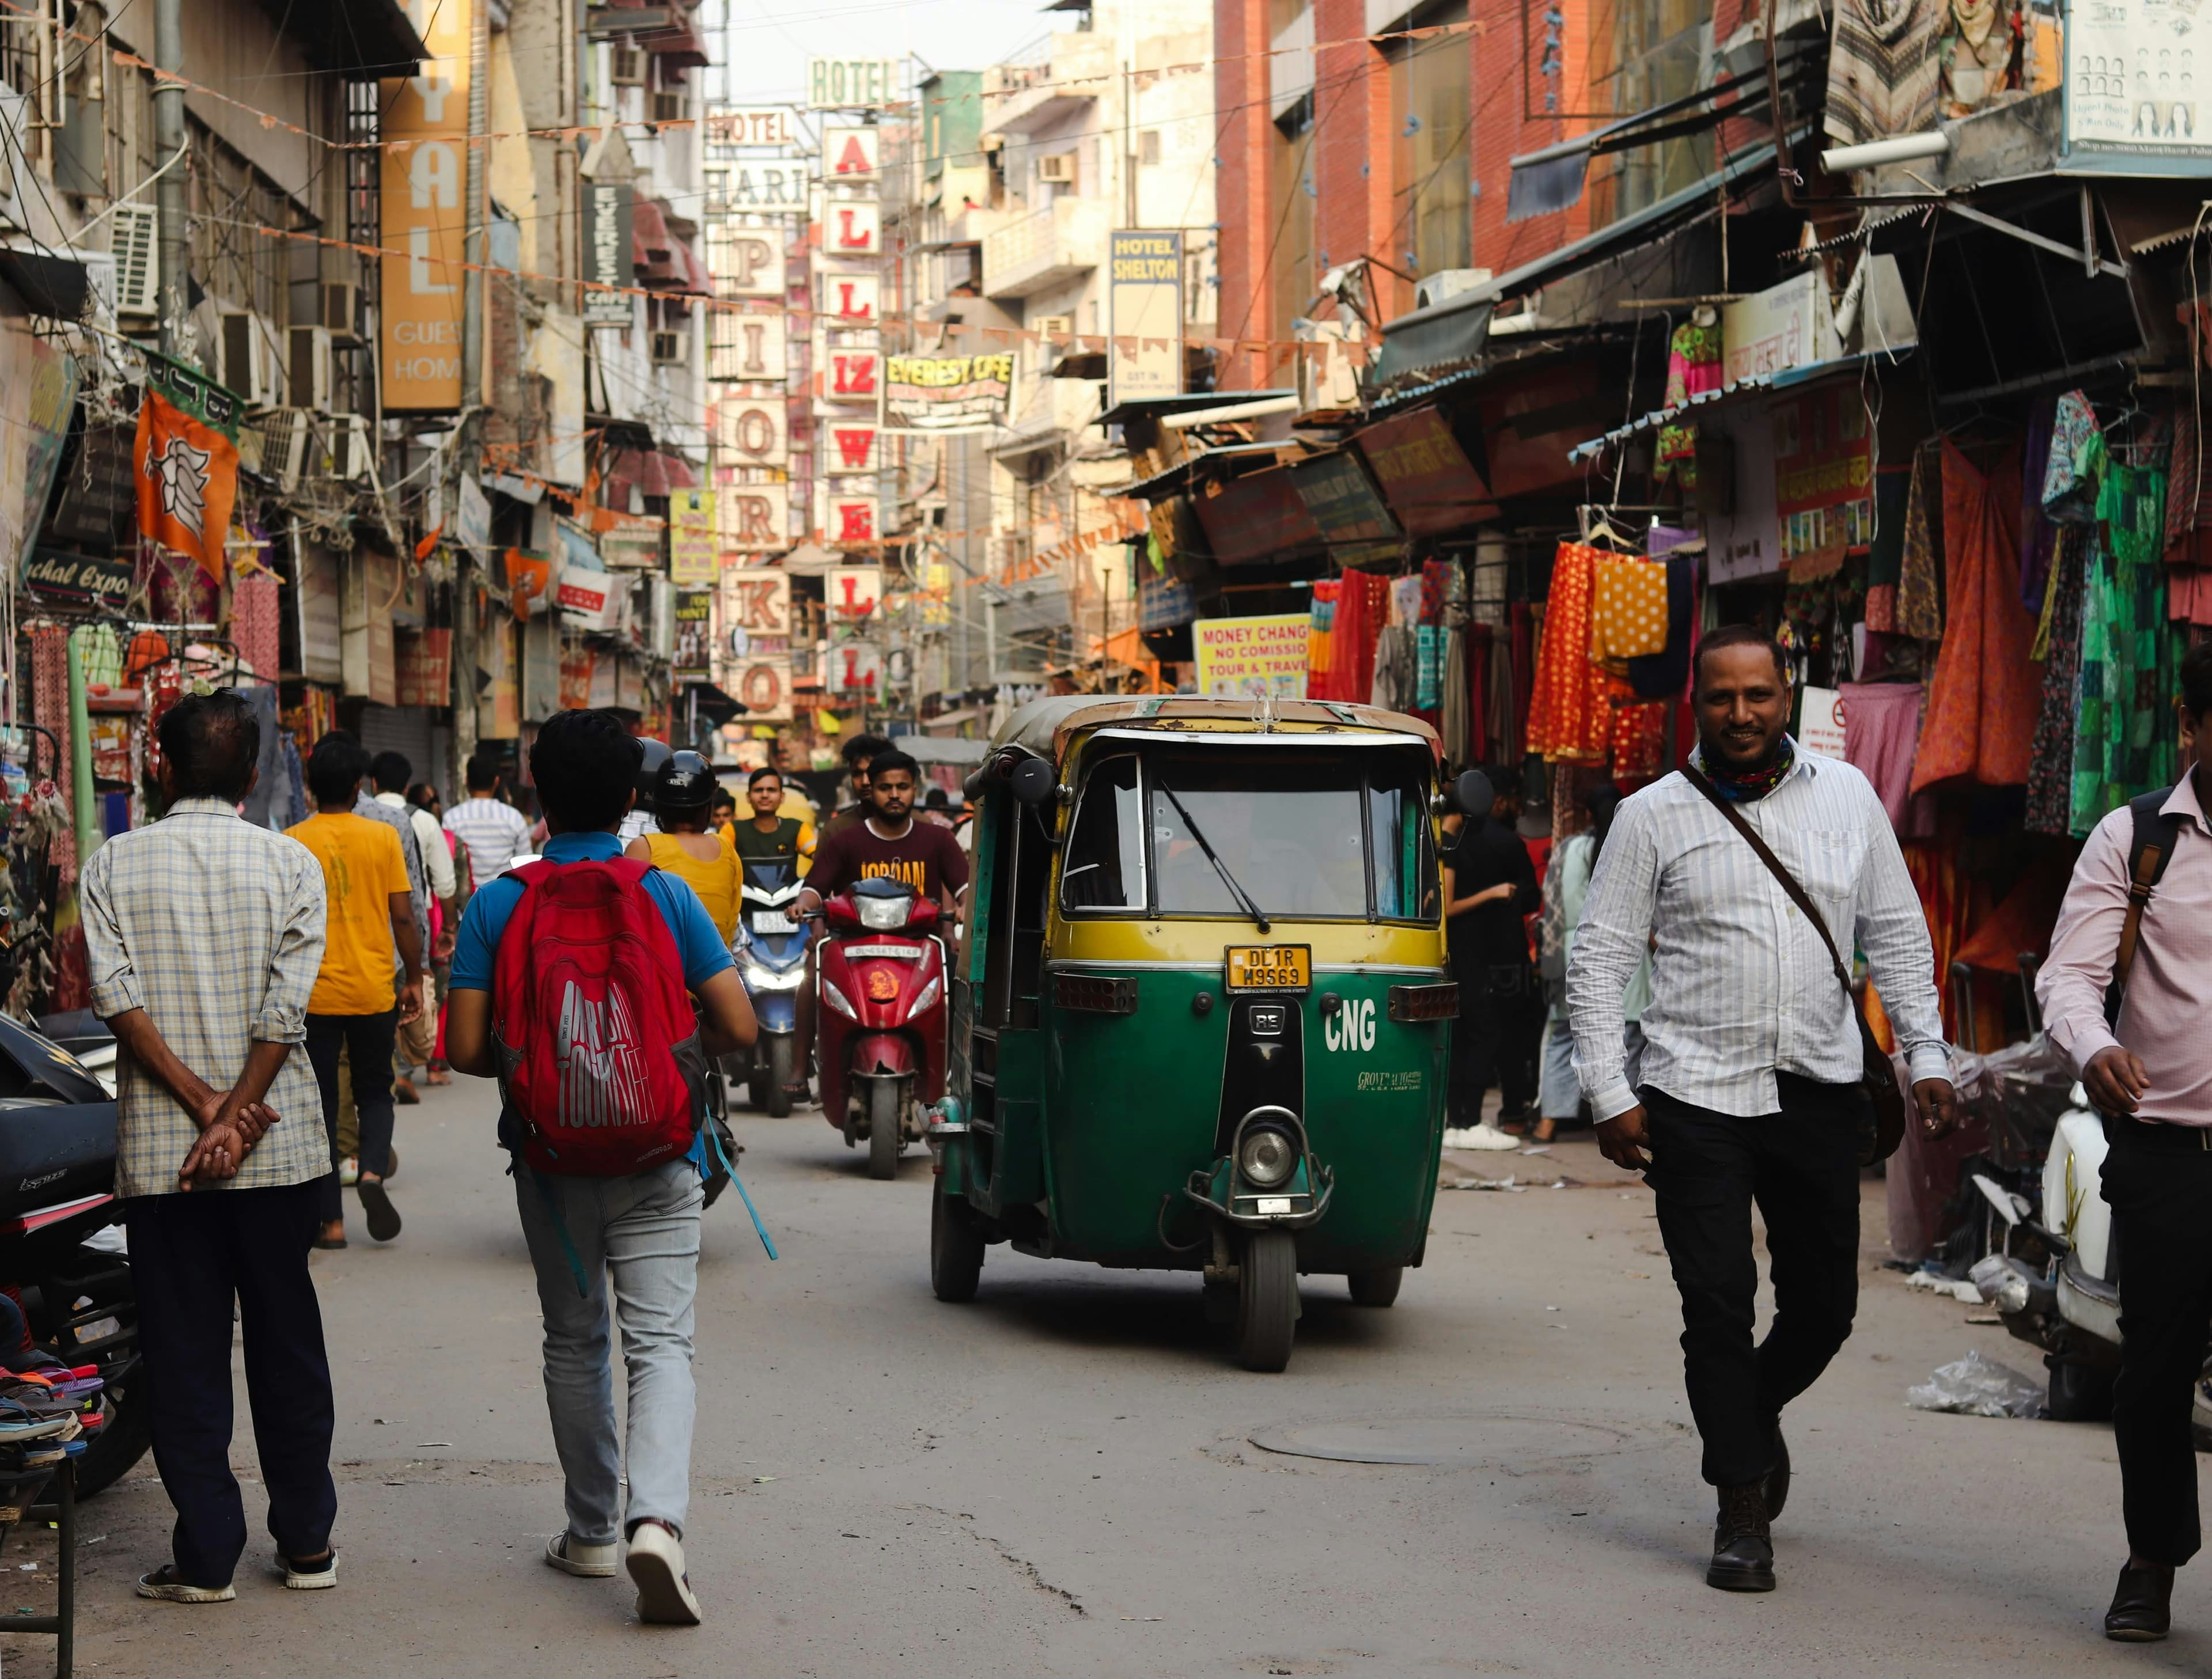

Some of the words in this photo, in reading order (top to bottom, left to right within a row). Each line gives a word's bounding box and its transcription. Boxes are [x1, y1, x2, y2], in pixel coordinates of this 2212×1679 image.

[813, 60, 894, 103] HOTEL
[704, 170, 803, 203] HARI
[594, 187, 619, 286] EVEREST
[1115, 239, 1174, 255] HOTEL
[1113, 259, 1177, 280] SHELTON
[1203, 628, 1252, 645] MONEY
[1258, 625, 1310, 640] CHANG
[1215, 648, 1234, 659] NO
[1207, 664, 1245, 676] TOUR
[1251, 662, 1260, 674] &
[1256, 1015, 1278, 1028] RE
[1325, 998, 1376, 1052] CNG
[557, 1043, 657, 1128] TOURISTER
